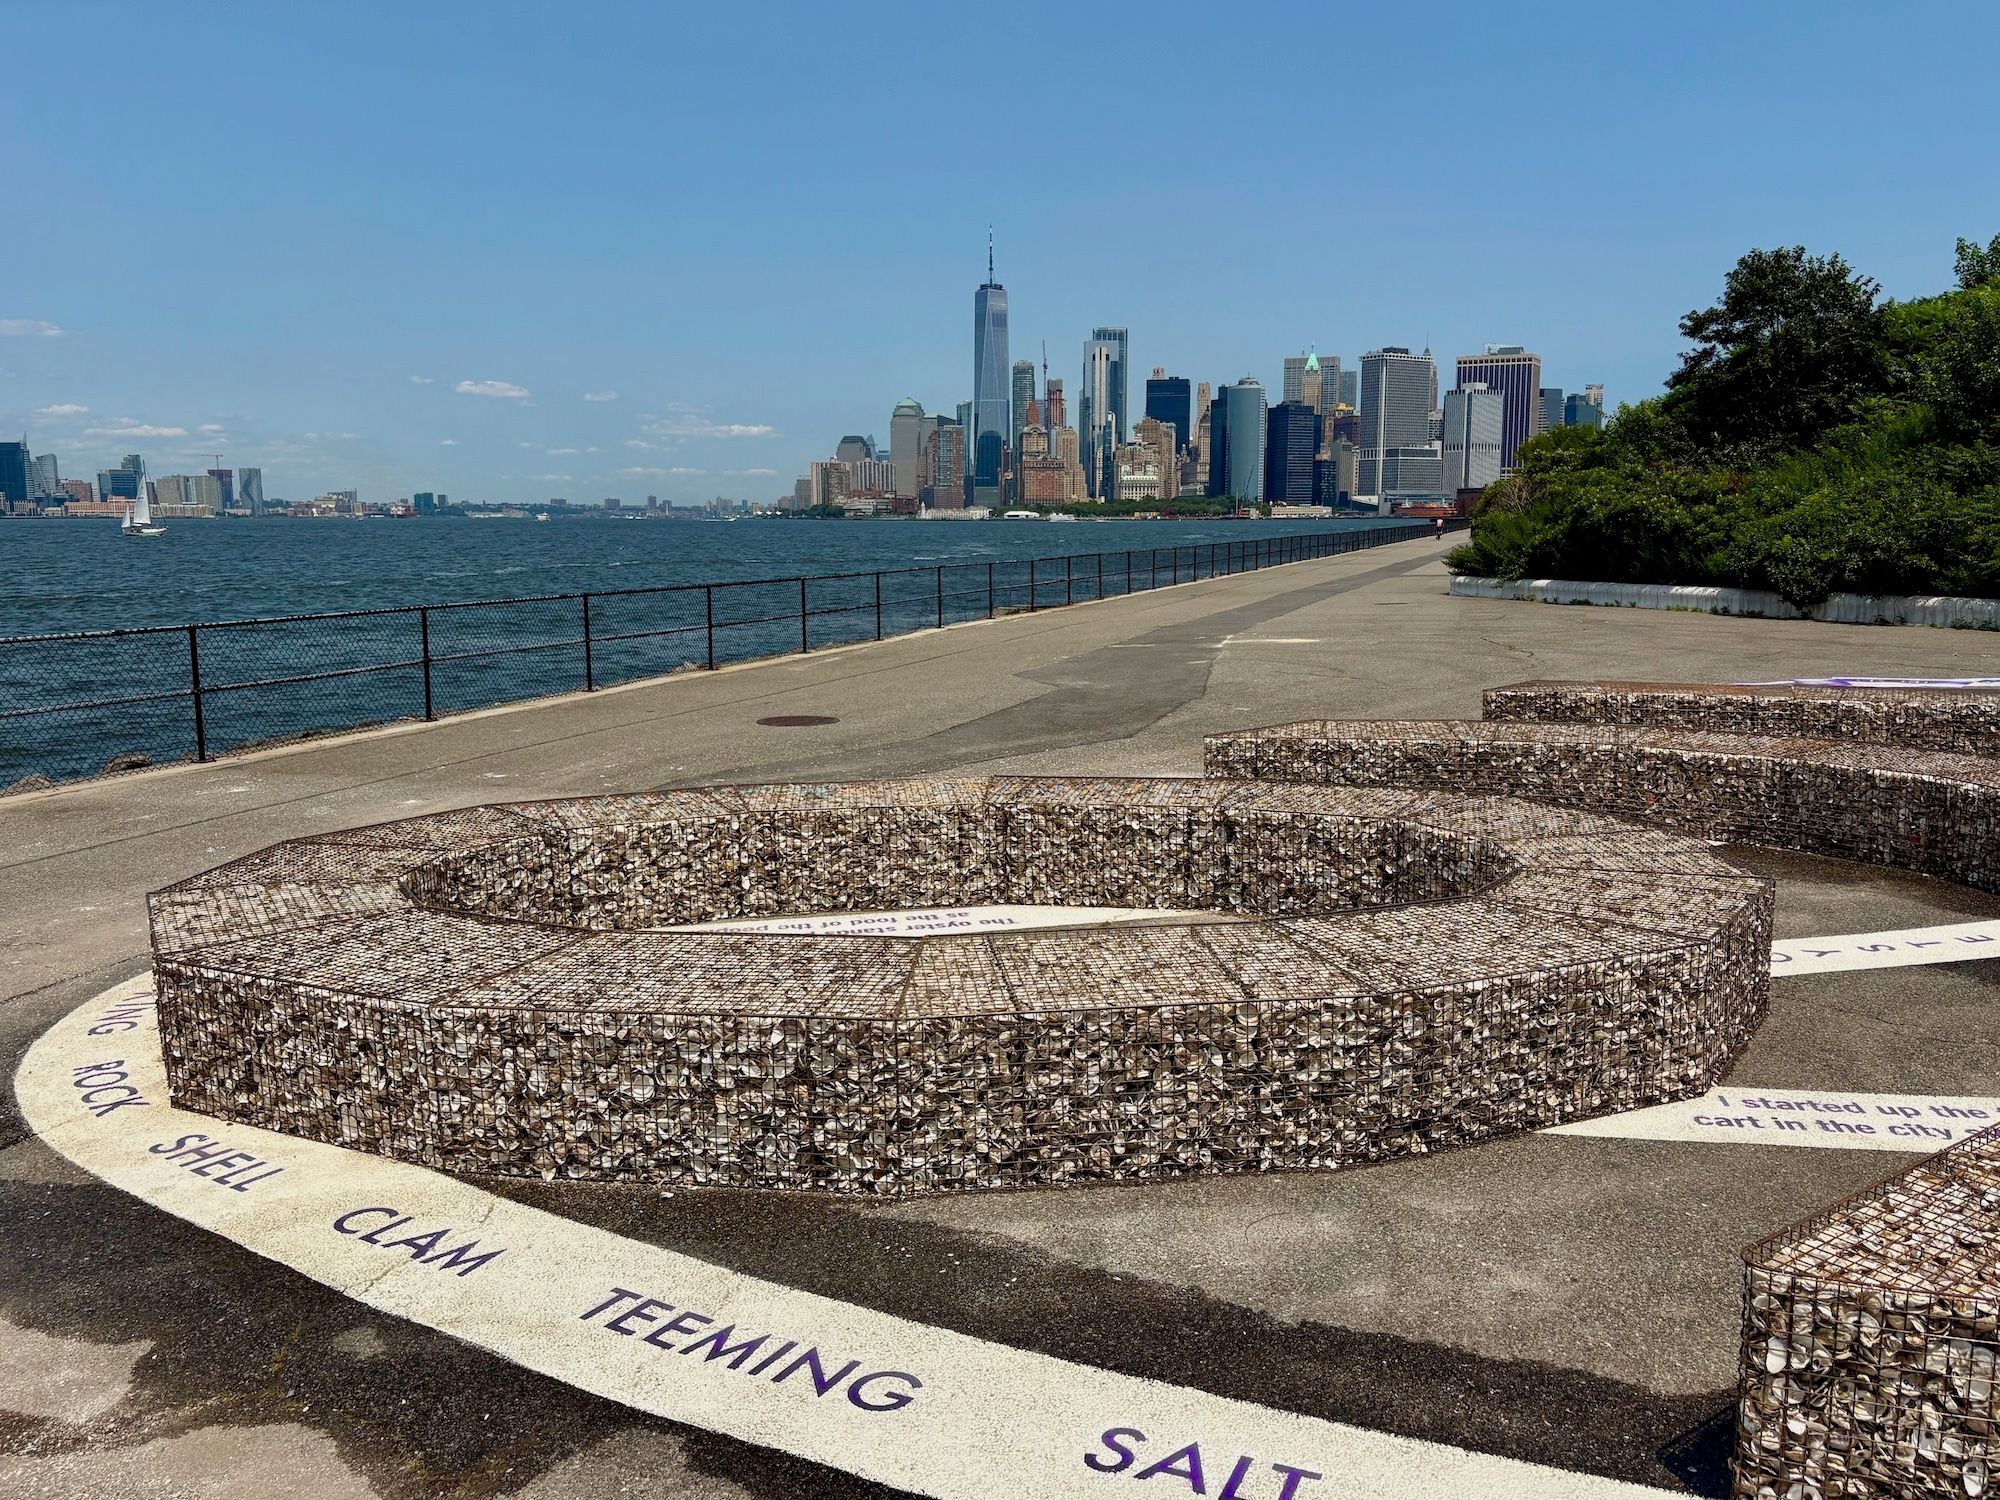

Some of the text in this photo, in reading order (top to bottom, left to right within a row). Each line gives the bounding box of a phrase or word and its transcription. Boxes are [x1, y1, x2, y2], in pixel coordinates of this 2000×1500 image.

[820, 920, 842, 928] of
[850, 917, 897, 926] food
[905, 920, 972, 931] oyster
[979, 917, 1017, 925] The
[777, 923, 811, 931] the
[1717, 1095, 1731, 1107] I
[1741, 1097, 1867, 1113] started
[1876, 1105, 1921, 1119] up
[1928, 1105, 1990, 1119] the
[1693, 1115, 1765, 1129] cart
[1771, 1116, 1808, 1131] in
[1815, 1119, 1876, 1134] the
[1888, 1123, 1953, 1141] city
[73, 1059, 150, 1118] ROCK
[148, 1134, 285, 1193] SHELL
[333, 1206, 508, 1278] CLAM
[579, 1287, 923, 1413] TEEMING
[1083, 1426, 1323, 1500] SALT
